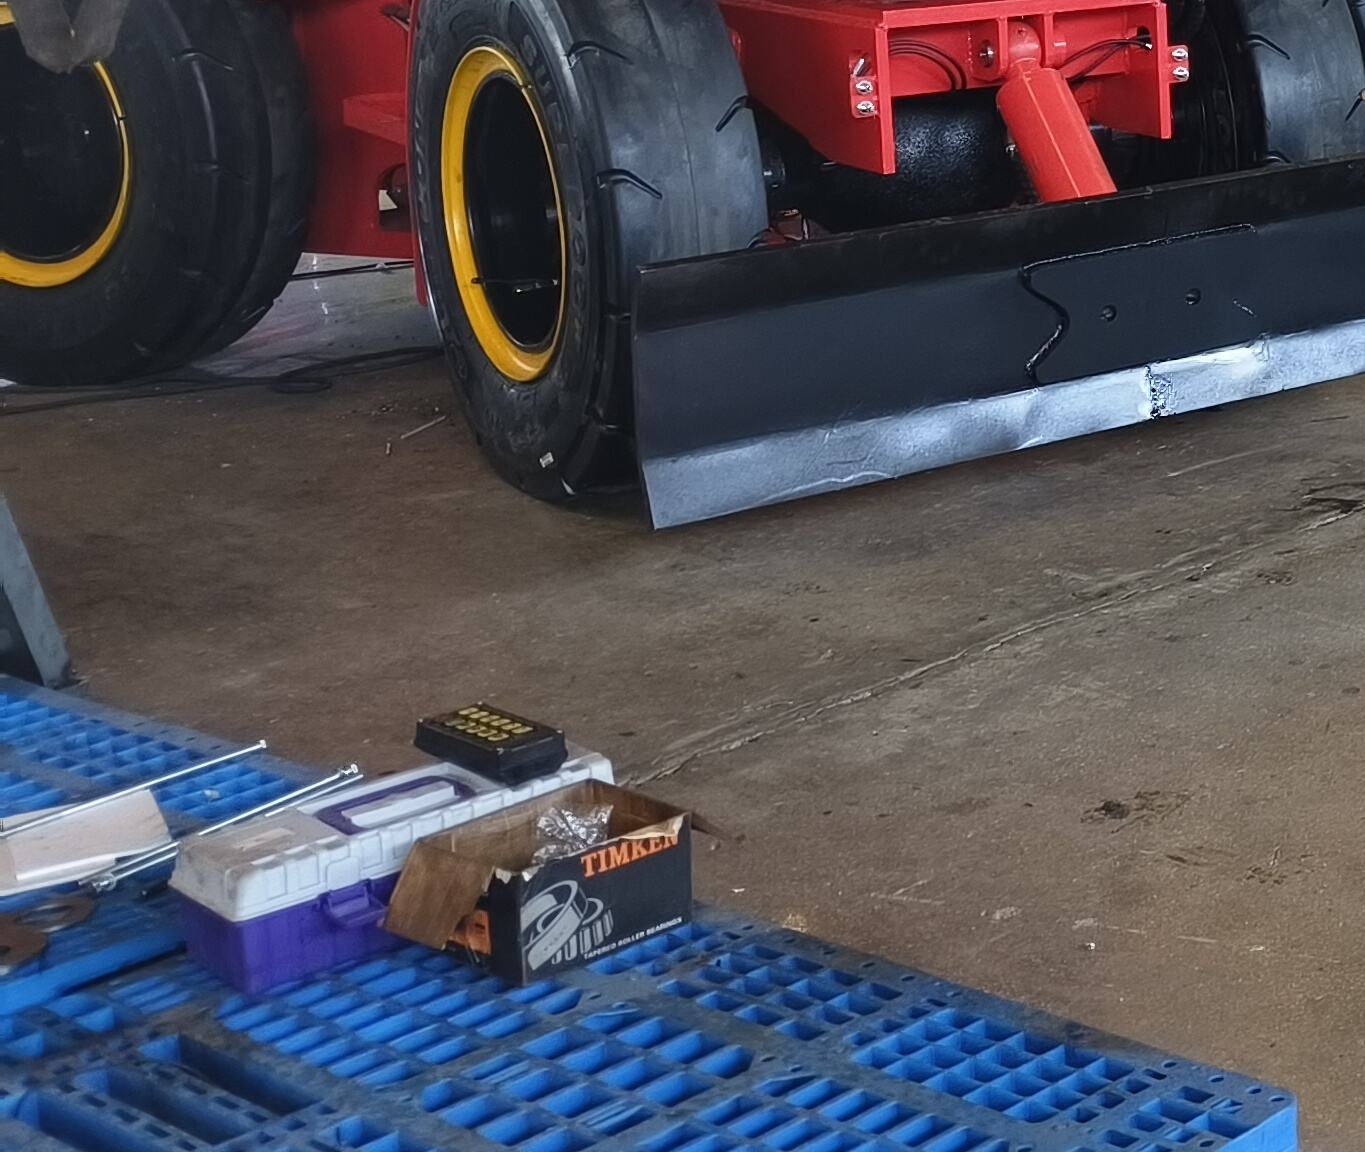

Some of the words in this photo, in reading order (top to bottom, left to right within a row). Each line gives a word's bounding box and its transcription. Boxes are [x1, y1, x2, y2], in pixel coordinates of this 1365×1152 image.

[584, 944, 616, 959] TAPERED
[618, 931, 645, 946] ROLLER
[646, 916, 682, 935] BEARINGS
